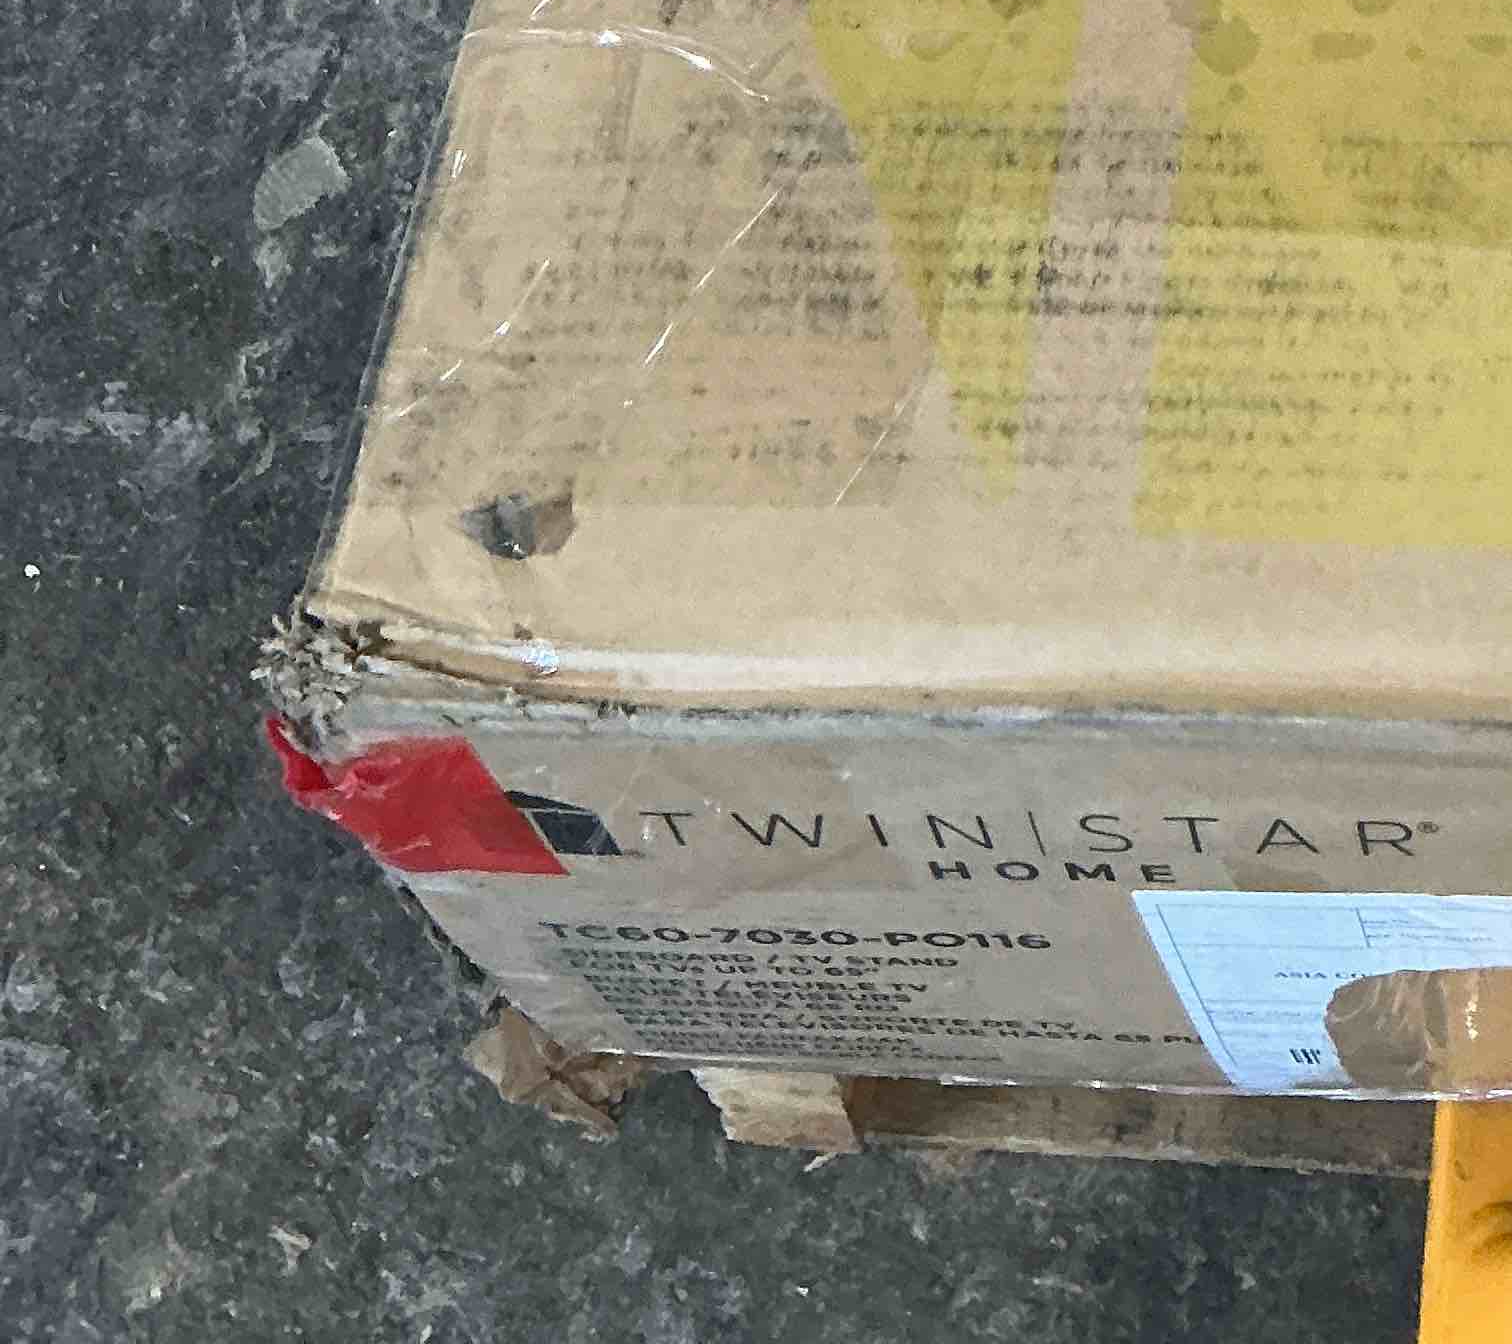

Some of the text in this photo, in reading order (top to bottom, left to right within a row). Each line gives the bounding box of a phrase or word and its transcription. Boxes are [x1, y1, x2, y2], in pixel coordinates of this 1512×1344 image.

[640, 810, 994, 854] TWIN
[928, 861, 1177, 884] HOME
[538, 921, 1051, 949] TC60-7030-PO116
[845, 956, 959, 967] STAND
